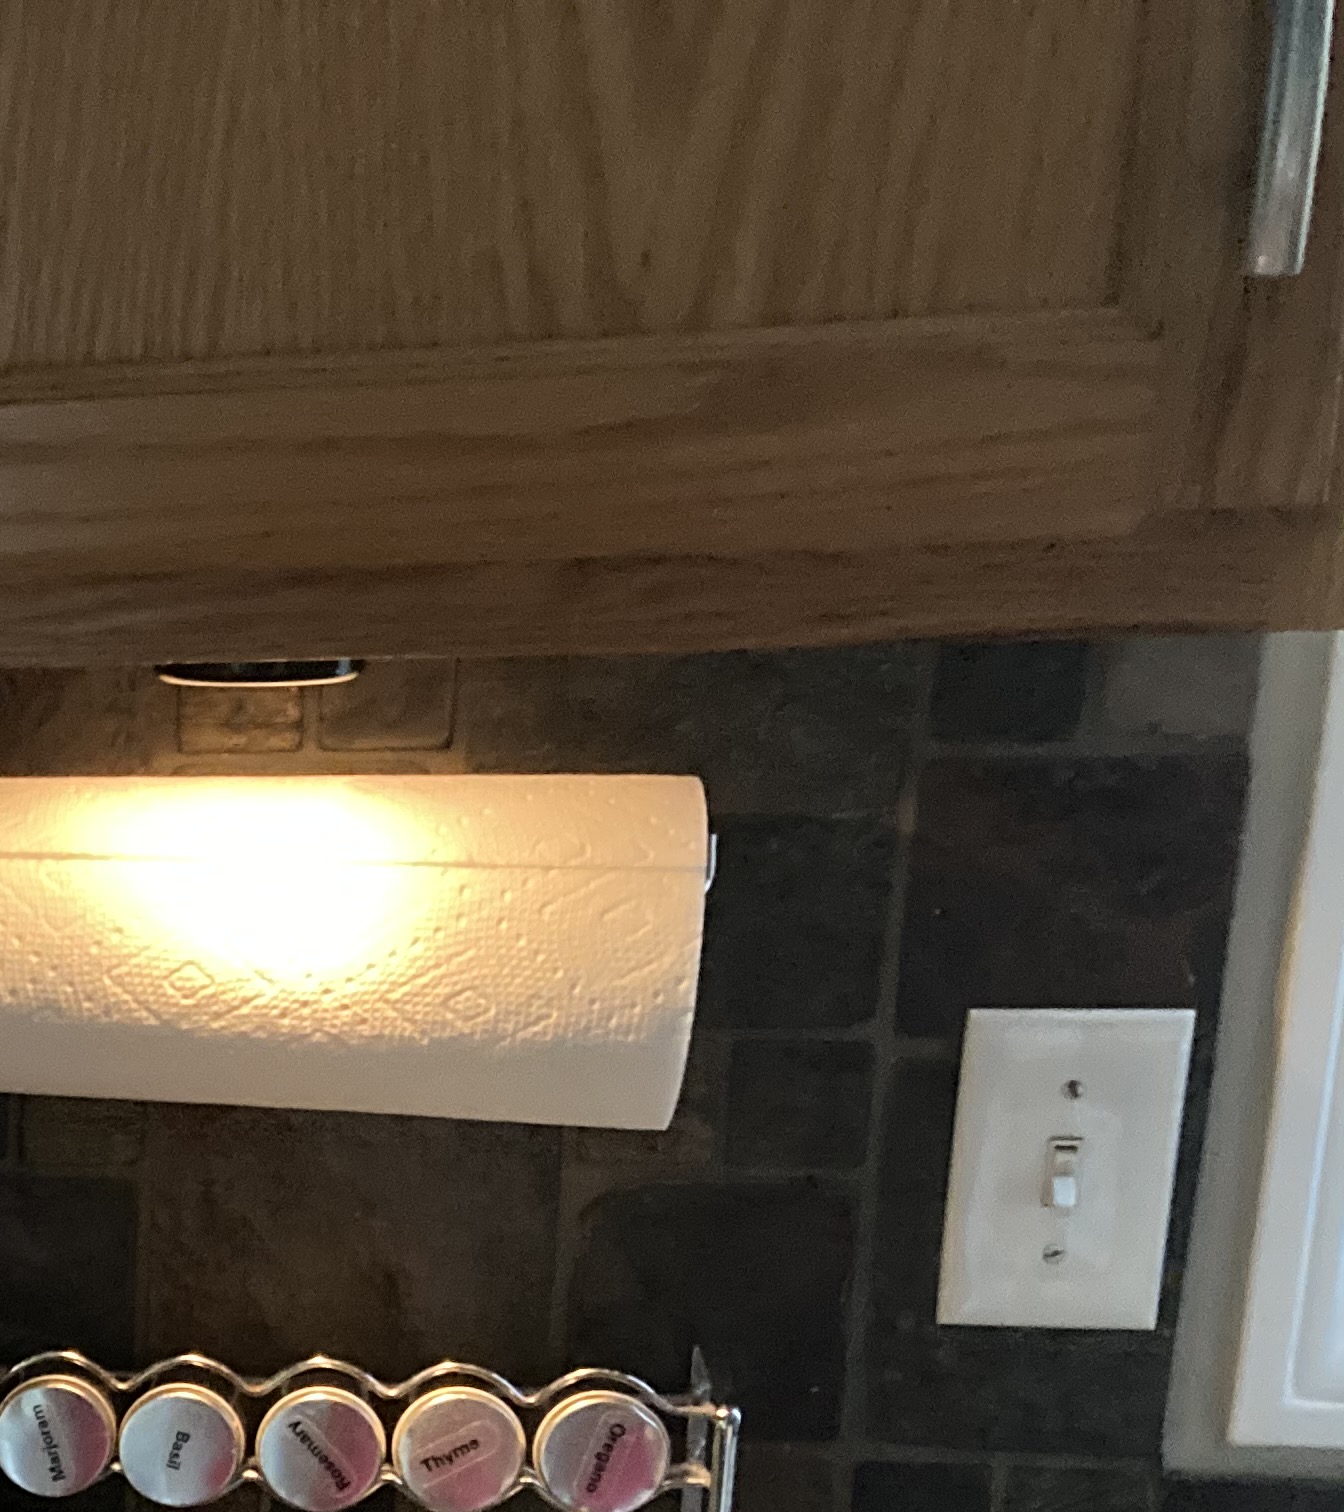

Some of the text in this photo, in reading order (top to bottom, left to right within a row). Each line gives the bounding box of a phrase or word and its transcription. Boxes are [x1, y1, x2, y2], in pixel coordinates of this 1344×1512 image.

[32, 1404, 67, 1482] Marjoram
[165, 1430, 191, 1472] Basil
[287, 1420, 352, 1492] Rosemary
[420, 1438, 481, 1474] Thyme
[585, 1422, 626, 1494] Oregano
